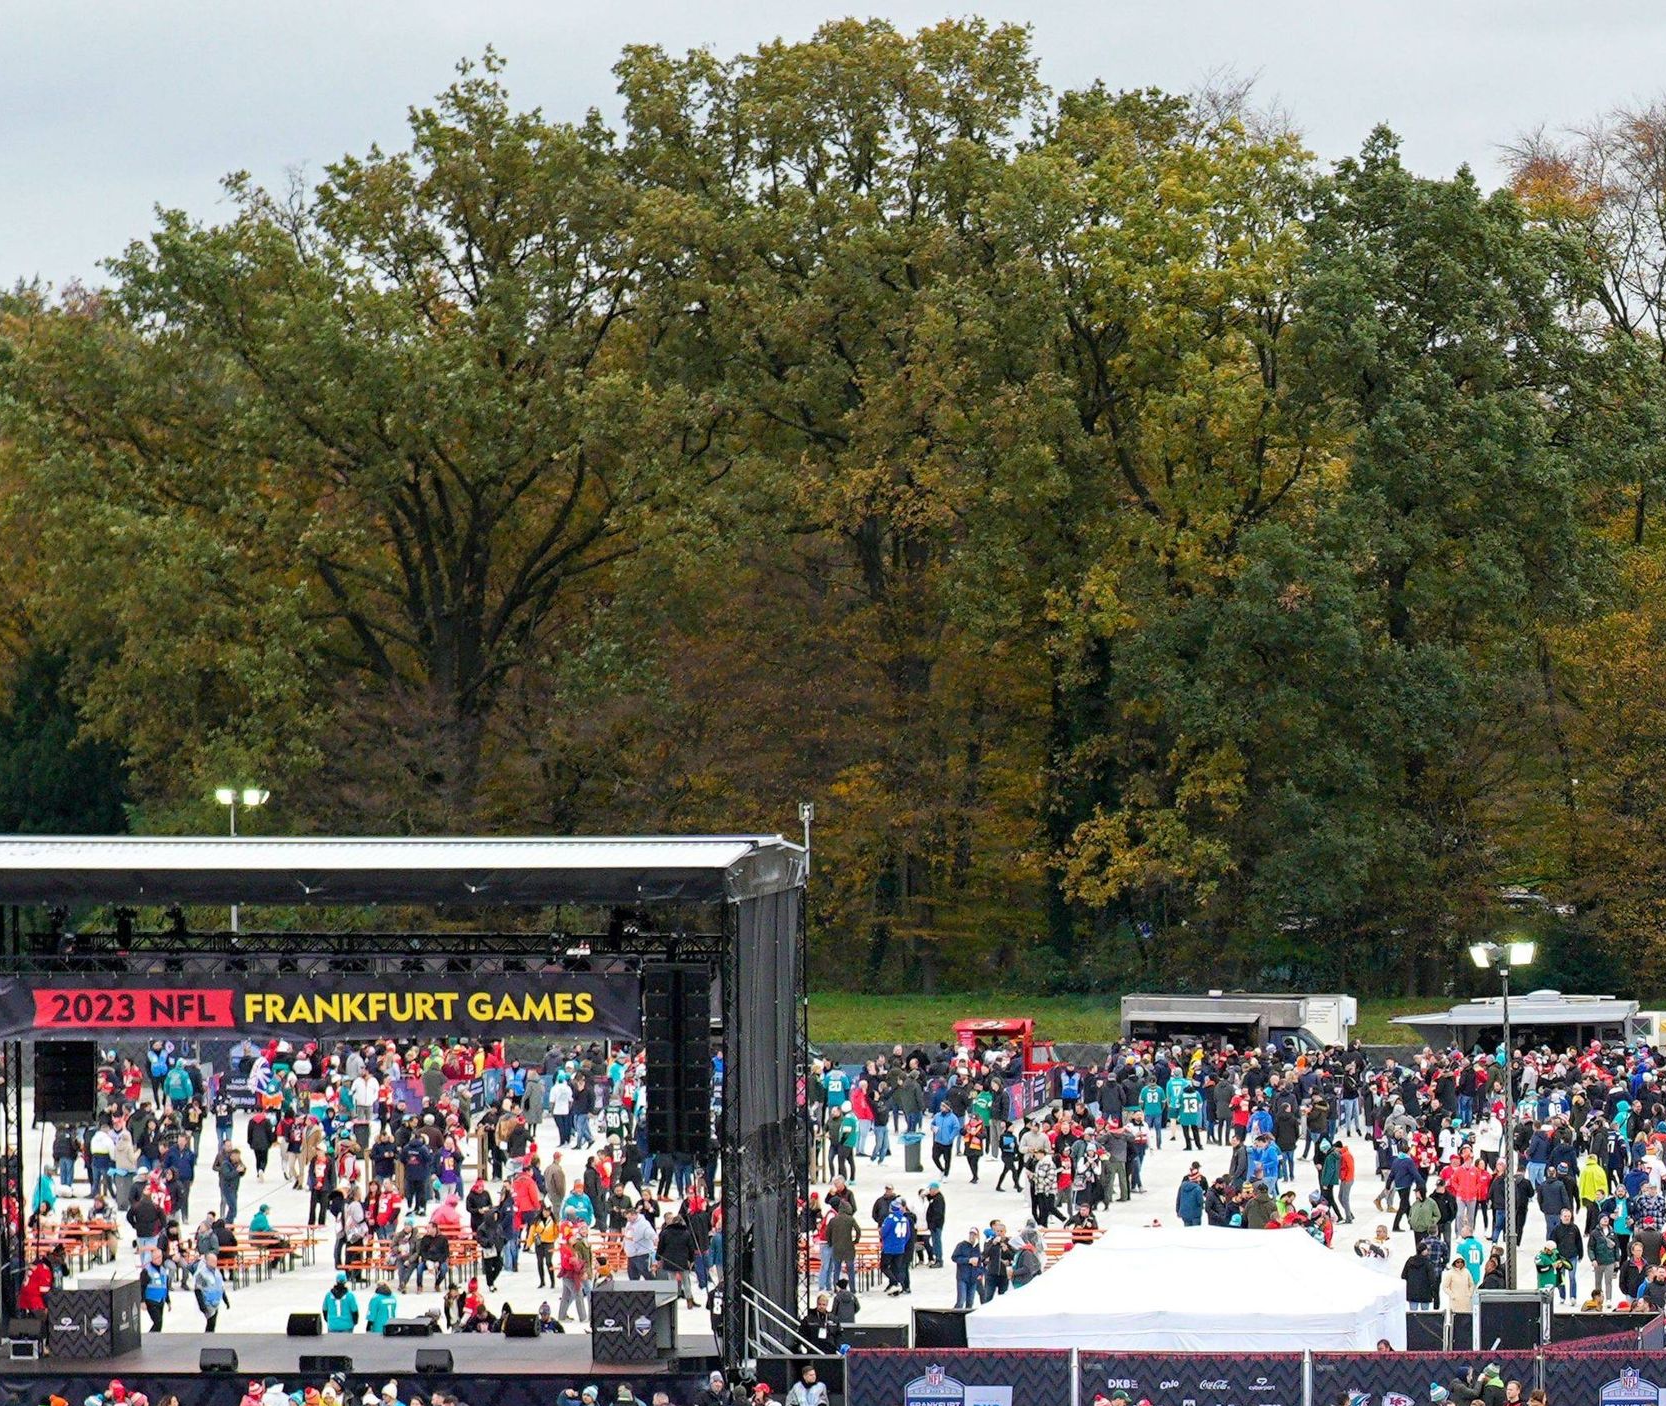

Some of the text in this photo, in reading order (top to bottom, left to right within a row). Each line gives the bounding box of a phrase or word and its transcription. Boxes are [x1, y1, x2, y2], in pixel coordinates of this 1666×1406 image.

[51, 992, 595, 1024] 2023 NFL FRANKFURT GAMES
[1183, 1098, 1199, 1114] 13
[1108, 1379, 1131, 1389] DKB
[1160, 1379, 1179, 1389] Chio
[1200, 1379, 1230, 1390] Coca-Cola
